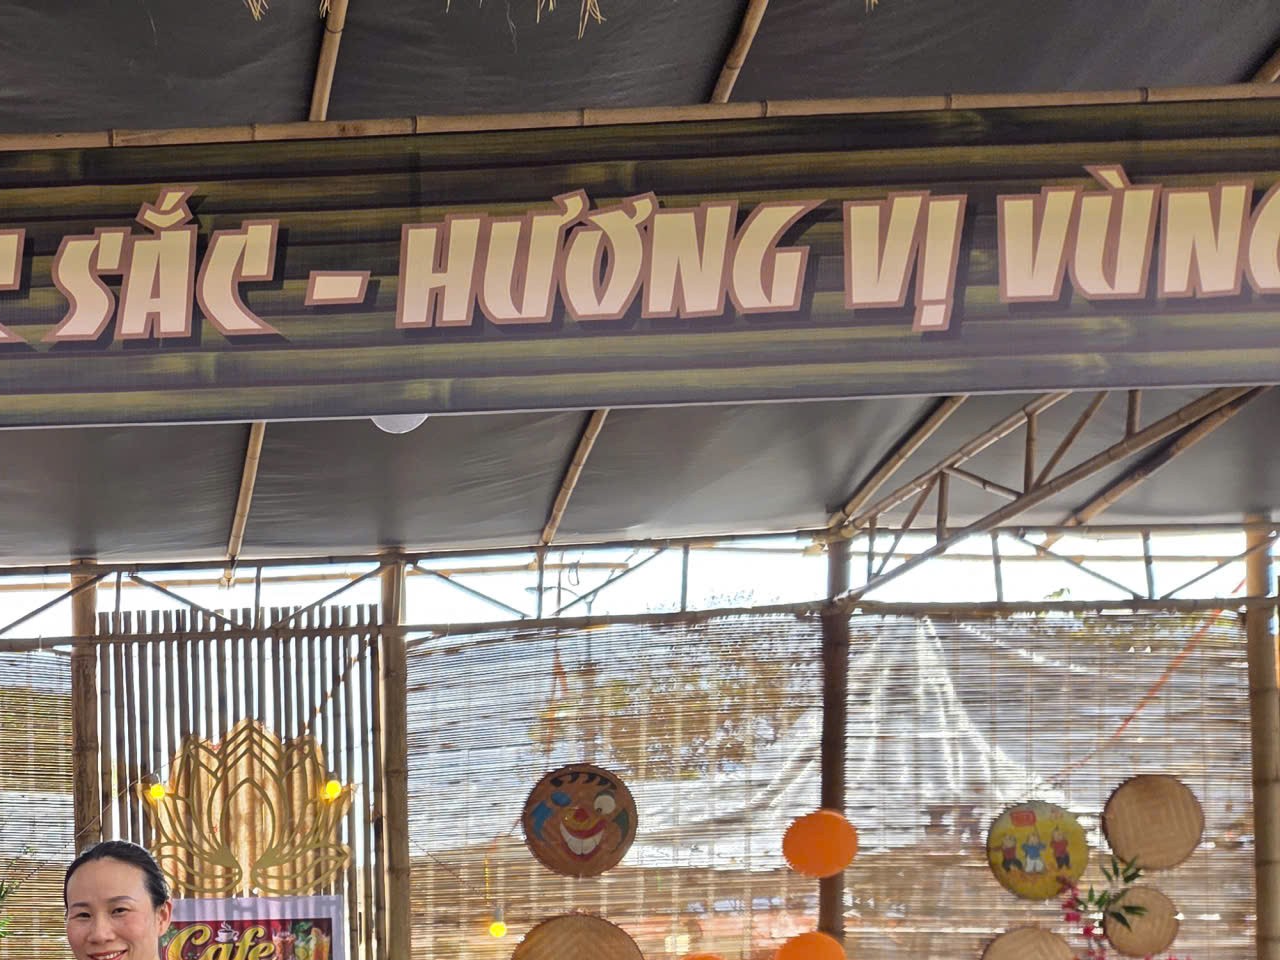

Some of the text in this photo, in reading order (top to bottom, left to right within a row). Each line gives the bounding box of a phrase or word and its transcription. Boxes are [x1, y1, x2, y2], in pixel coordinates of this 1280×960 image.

[41, 186, 280, 343] SẮC
[396, 188, 826, 330] HƯƠNG
[843, 190, 967, 332] VỊ
